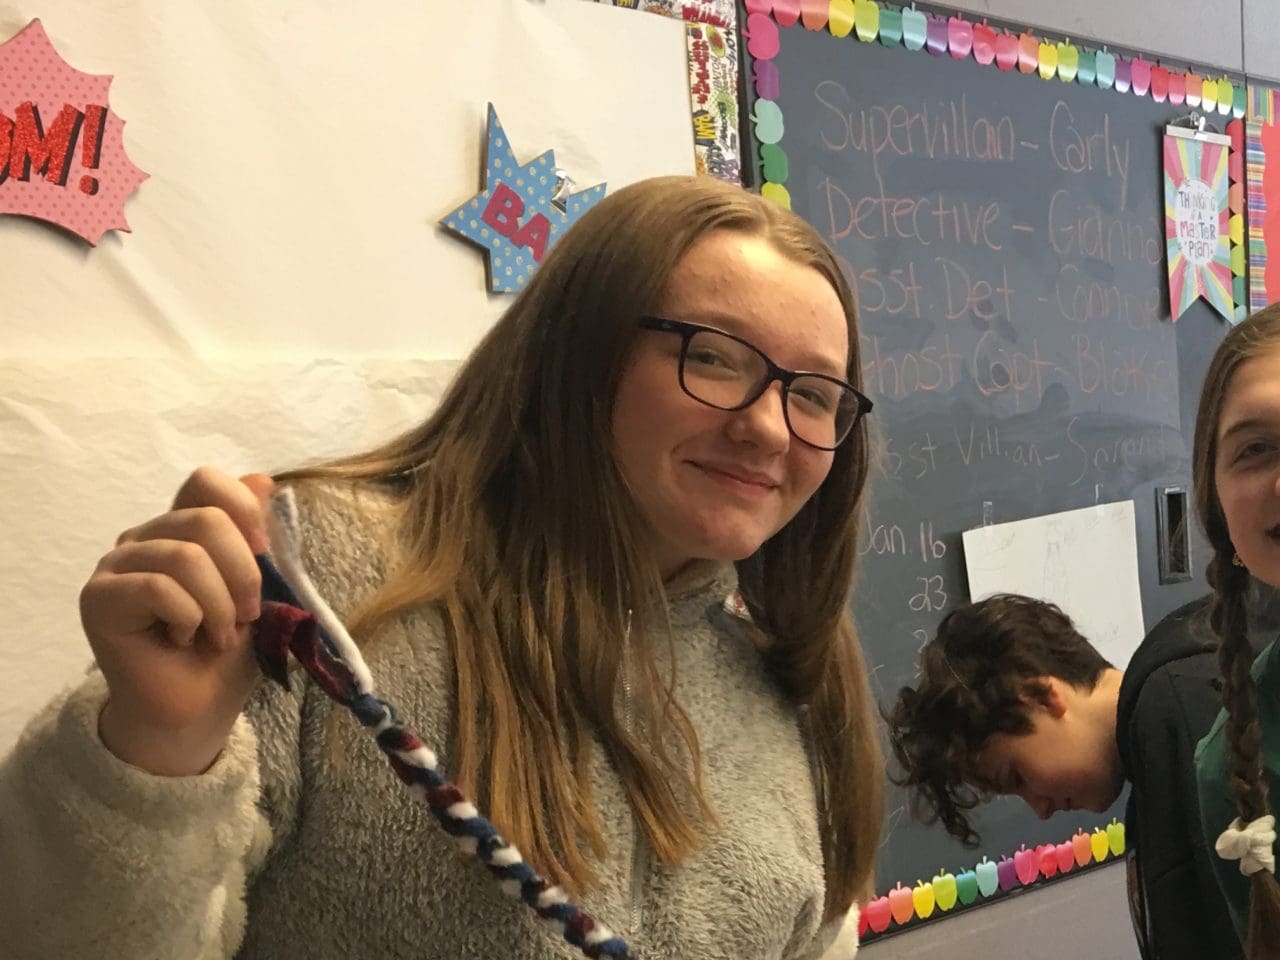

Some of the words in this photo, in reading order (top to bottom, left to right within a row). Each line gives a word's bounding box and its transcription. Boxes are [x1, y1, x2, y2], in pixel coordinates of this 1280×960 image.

[816, 176, 1002, 251] Detective
[919, 521, 947, 562] 16
[908, 574, 947, 612] 23
